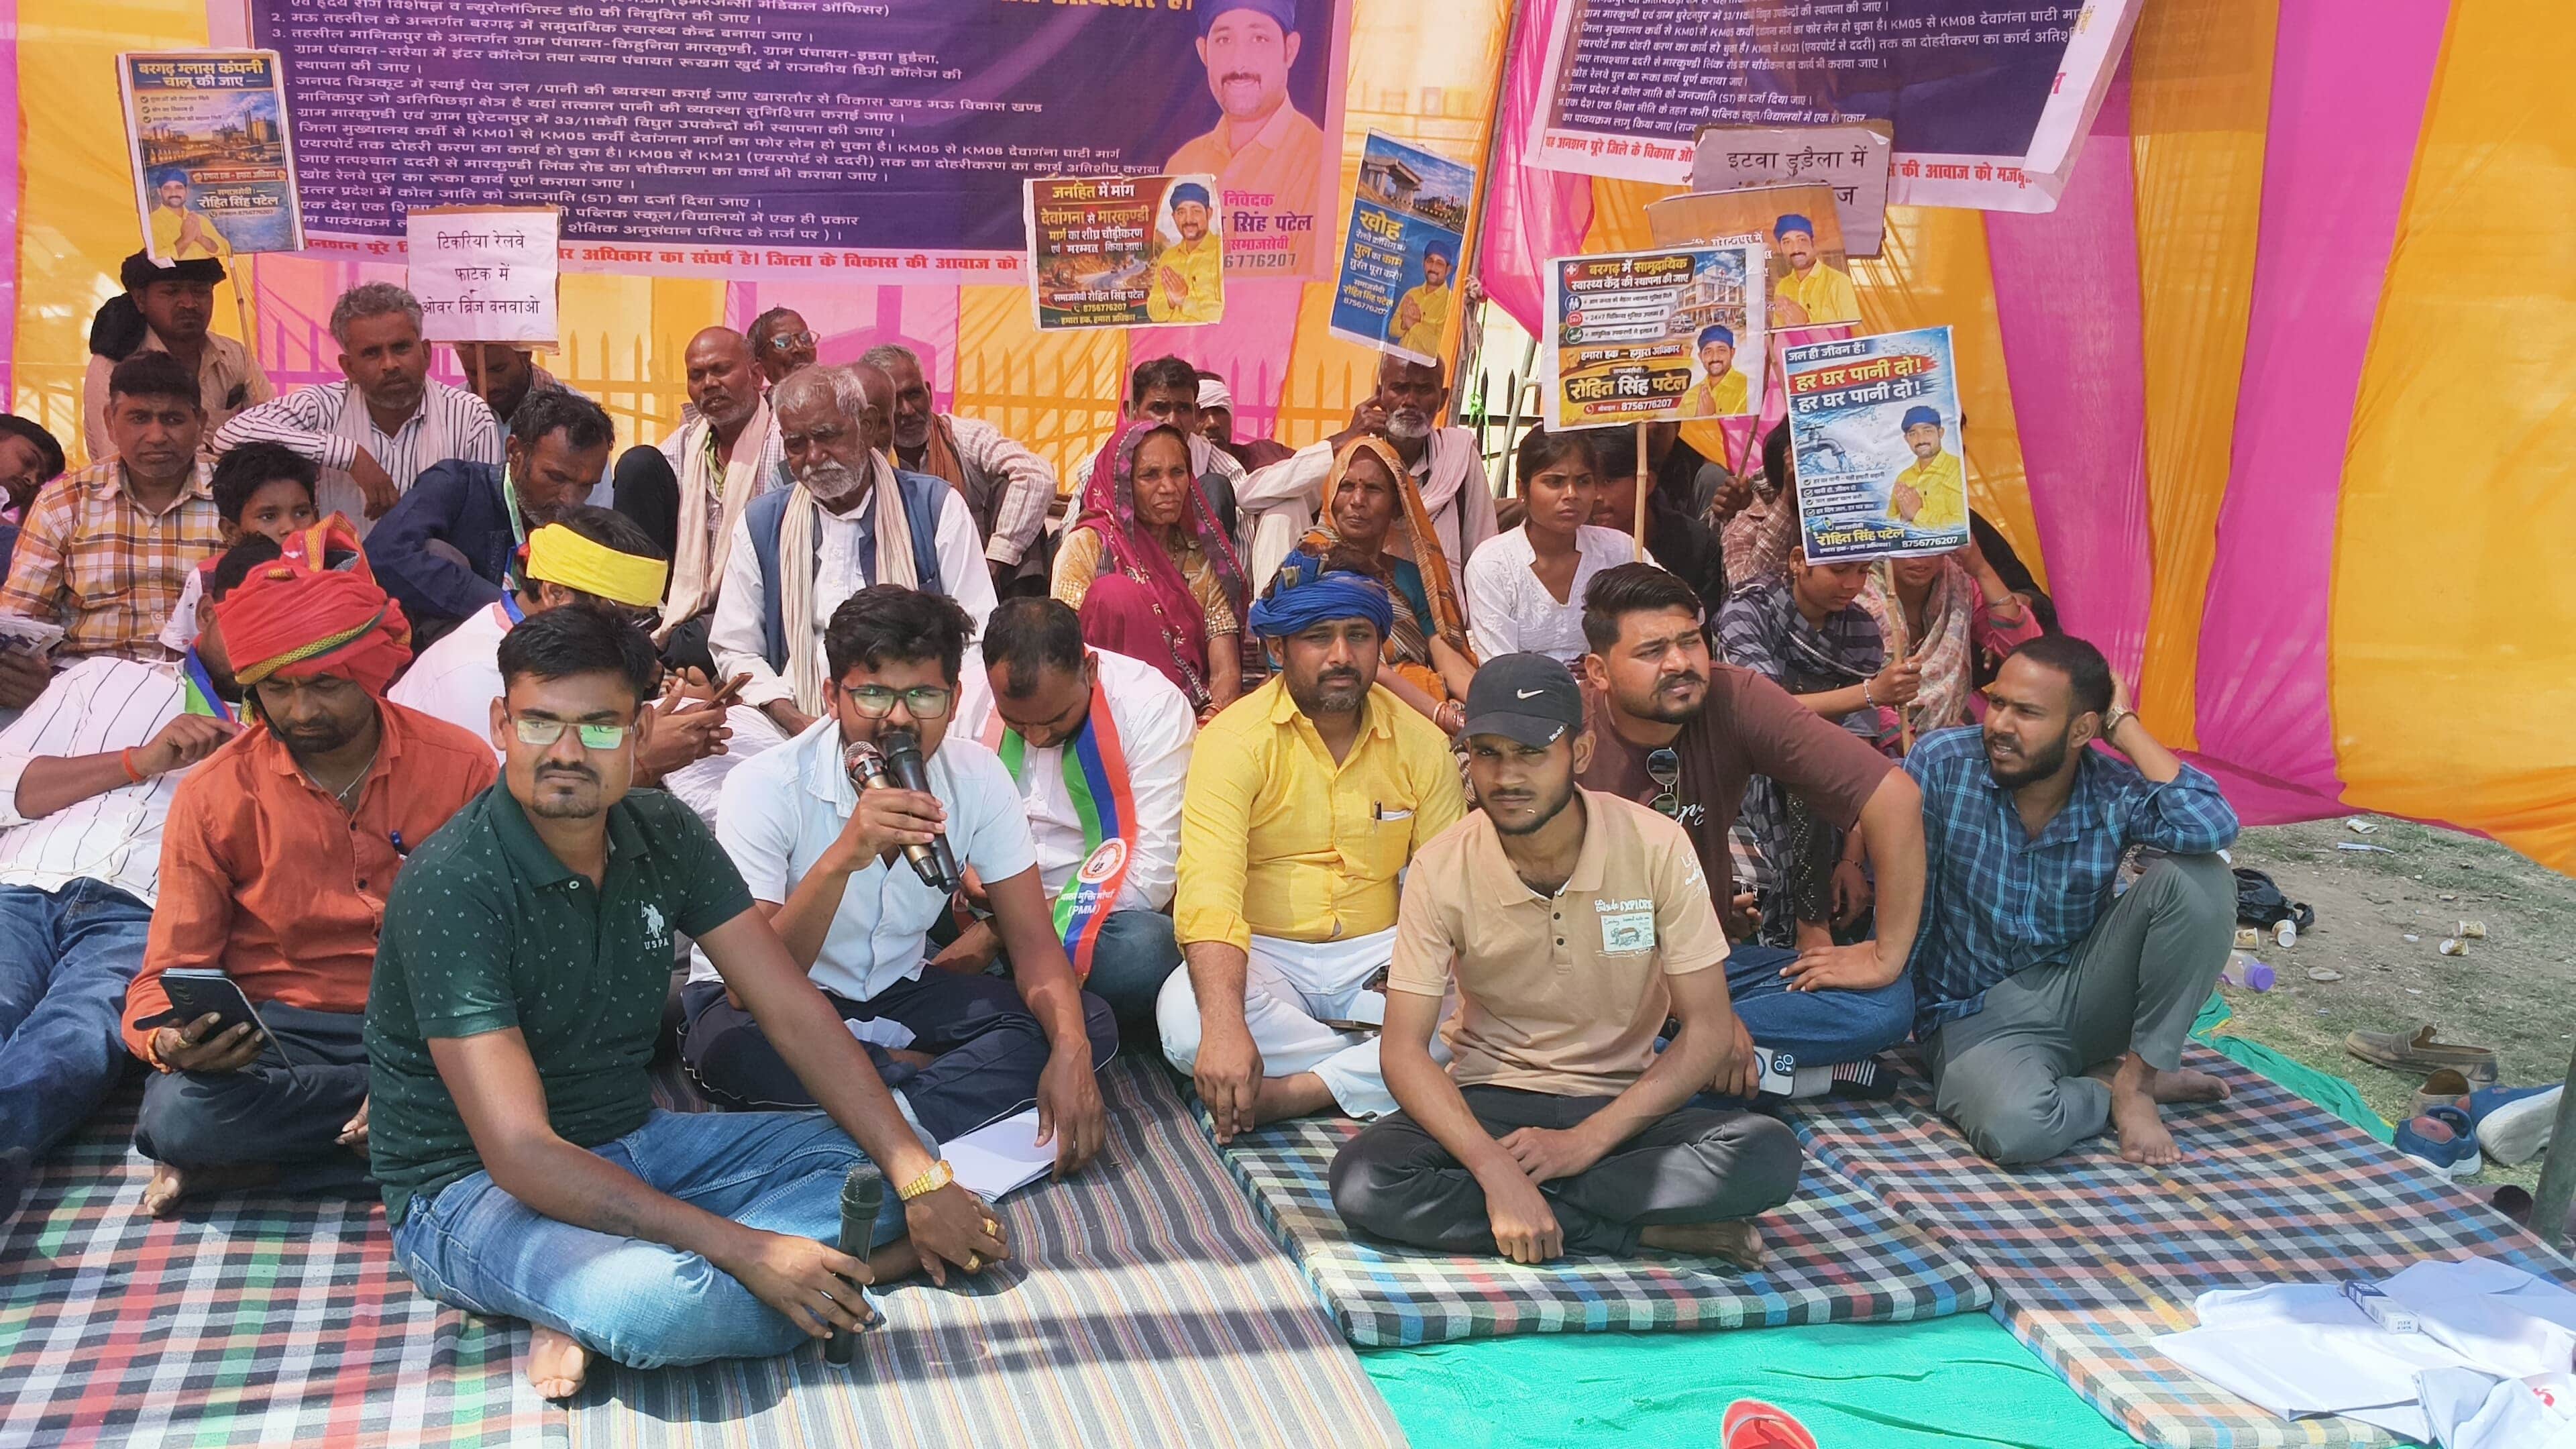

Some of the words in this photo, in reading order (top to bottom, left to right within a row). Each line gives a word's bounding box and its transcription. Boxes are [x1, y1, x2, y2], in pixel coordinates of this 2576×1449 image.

[271, 13, 286, 22] 2.
[292, 13, 319, 23] मऊ
[323, 12, 379, 24] तहसील
[385, 14, 400, 25] के
[406, 15, 464, 28] अन्तर्गत
[521, 18, 534, 31] में
[539, 21, 617, 34] समुदायिक
[623, 24, 676, 36] स्वास्थ्य
[682, 25, 715, 38] केन्द्र
[720, 30, 765, 40] बनाया
[771, 31, 802, 42] जाए
[1890, 19, 1922, 29] KM05
[1927, 15, 1937, 28] से
[1941, 16, 1975, 27] KM08
[2031, 7, 2057, 22] घाटी
[1879, 38, 1897, 49] तक
[1902, 38, 1917, 48] का
[1921, 34, 1979, 48] दोहरीकरण
[1983, 34, 2000, 45] का
[2004, 30, 2030, 44] कार्य
[178, 62, 215, 75] ग्लास
[218, 60, 264, 74] कंपनी
[163, 75, 195, 89] चालू
[196, 75, 215, 86] की
[219, 76, 244, 87] जाए
[299, 121, 336, 133] जिला
[341, 123, 409, 136] मुख्यालय
[415, 123, 447, 137] कर्वी
[452, 125, 466, 138] से
[472, 128, 513, 138] KM01
[521, 127, 534, 139] से
[541, 131, 586, 140] KM05
[693, 134, 725, 146] मार्ग
[729, 138, 749, 147] का
[755, 137, 784, 149] फोर
[788, 138, 815, 150] लेन
[820, 138, 836, 150] हो
[840, 142, 872, 152] चुका
[898, 144, 939, 154] KM05
[945, 144, 957, 155] से
[962, 146, 1003, 156] KM08
[1063, 147, 1091, 160] घाटी
[1095, 148, 1120, 160] मार्ग
[1591, 138, 1604, 156] पूरे
[1607, 140, 1628, 156] जिले
[1631, 142, 1642, 156] के
[1644, 144, 1676, 160] विकास
[1727, 152, 1780, 172] इटवा
[1850, 146, 1868, 167] में
[1902, 160, 1919, 177] की
[1925, 164, 1970, 180] आवाज
[1974, 162, 1992, 182] को
[300, 186, 335, 196] उत्तर
[341, 185, 373, 197] प्रदेश
[378, 186, 392, 197] में
[397, 186, 433, 199] कोल
[438, 187, 476, 199] जाति
[482, 189, 504, 200] को
[508, 191, 576, 202] जनजाति
[582, 193, 611, 204] (ST)
[617, 195, 639, 204] का
[644, 194, 675, 205] दर्जा
[681, 195, 714, 207] दिया
[719, 197, 750, 207] जाए
[1053, 183, 1095, 199] जनहित
[1099, 183, 1108, 197] में
[1111, 184, 1134, 197] मांग
[1223, 191, 1275, 207] निवेदक
[197, 195, 229, 209] रोहित
[230, 196, 250, 208] सिंह
[253, 195, 279, 206] पटेल
[1087, 214, 1095, 225] से
[1097, 206, 1149, 226] मारकुण्डी
[1233, 211, 1269, 232] सिंह
[1275, 211, 1313, 231] पटेल
[1360, 209, 1403, 240] खोह
[437, 231, 489, 249] टिकरिया
[492, 230, 525, 248] रेलवे
[1049, 230, 1067, 241] मार्ग
[1068, 230, 1080, 240] का
[1081, 229, 1100, 240] शीघ्र
[1230, 235, 1289, 250] समाजसेवी
[582, 246, 652, 262] अधिकार
[659, 250, 684, 263] का
[691, 250, 734, 265] संघर्ष
[766, 251, 812, 267] जिला
[820, 252, 837, 268] के
[843, 252, 899, 268] विकास
[905, 254, 930, 269] की
[936, 258, 989, 270] आवाज
[998, 255, 1018, 270] को
[1224, 254, 1296, 268] 6776207
[1354, 243, 1371, 258] पुल
[1371, 252, 1381, 261] का
[1382, 254, 1403, 267] काम
[455, 268, 491, 281] फाटक
[499, 263, 510, 280] में
[1350, 258, 1368, 270] तुरंत
[1370, 264, 1382, 276] पूरा
[1621, 260, 1631, 273] में
[1634, 257, 1687, 274] सामुदायिक
[1603, 275, 1619, 289] केंद्र
[1621, 276, 1633, 287] की
[1662, 274, 1671, 283] की
[1673, 274, 1688, 284] जाए
[1088, 291, 1109, 301] रोहित
[1111, 290, 1126, 301] सिंह
[1128, 289, 1144, 299] पटेल
[423, 297, 454, 314] ओवर
[1788, 350, 1807, 362] जल
[1809, 347, 1819, 360] ही
[1821, 344, 1849, 358] जीवन
[1796, 375, 1817, 391] हर
[1821, 372, 1845, 386] घर
[1849, 363, 1890, 382] पानी
[1894, 357, 1922, 374] दो!
[1570, 379, 1613, 399] रोहित
[1618, 375, 1649, 395] सिंह
[1652, 374, 1688, 390] पटेल
[1798, 396, 1818, 413] हर
[1822, 393, 1845, 407] घर
[1849, 384, 1890, 404] पानी
[1894, 379, 1922, 398] दो!
[1815, 533, 1851, 546] रोहित
[1854, 529, 1876, 541] सिंह
[1876, 527, 1905, 539] पटेल
[1902, 537, 1957, 548] 8756776207
[1067, 904, 1101, 917] (PMM)
[644, 938, 669, 950] USPA
